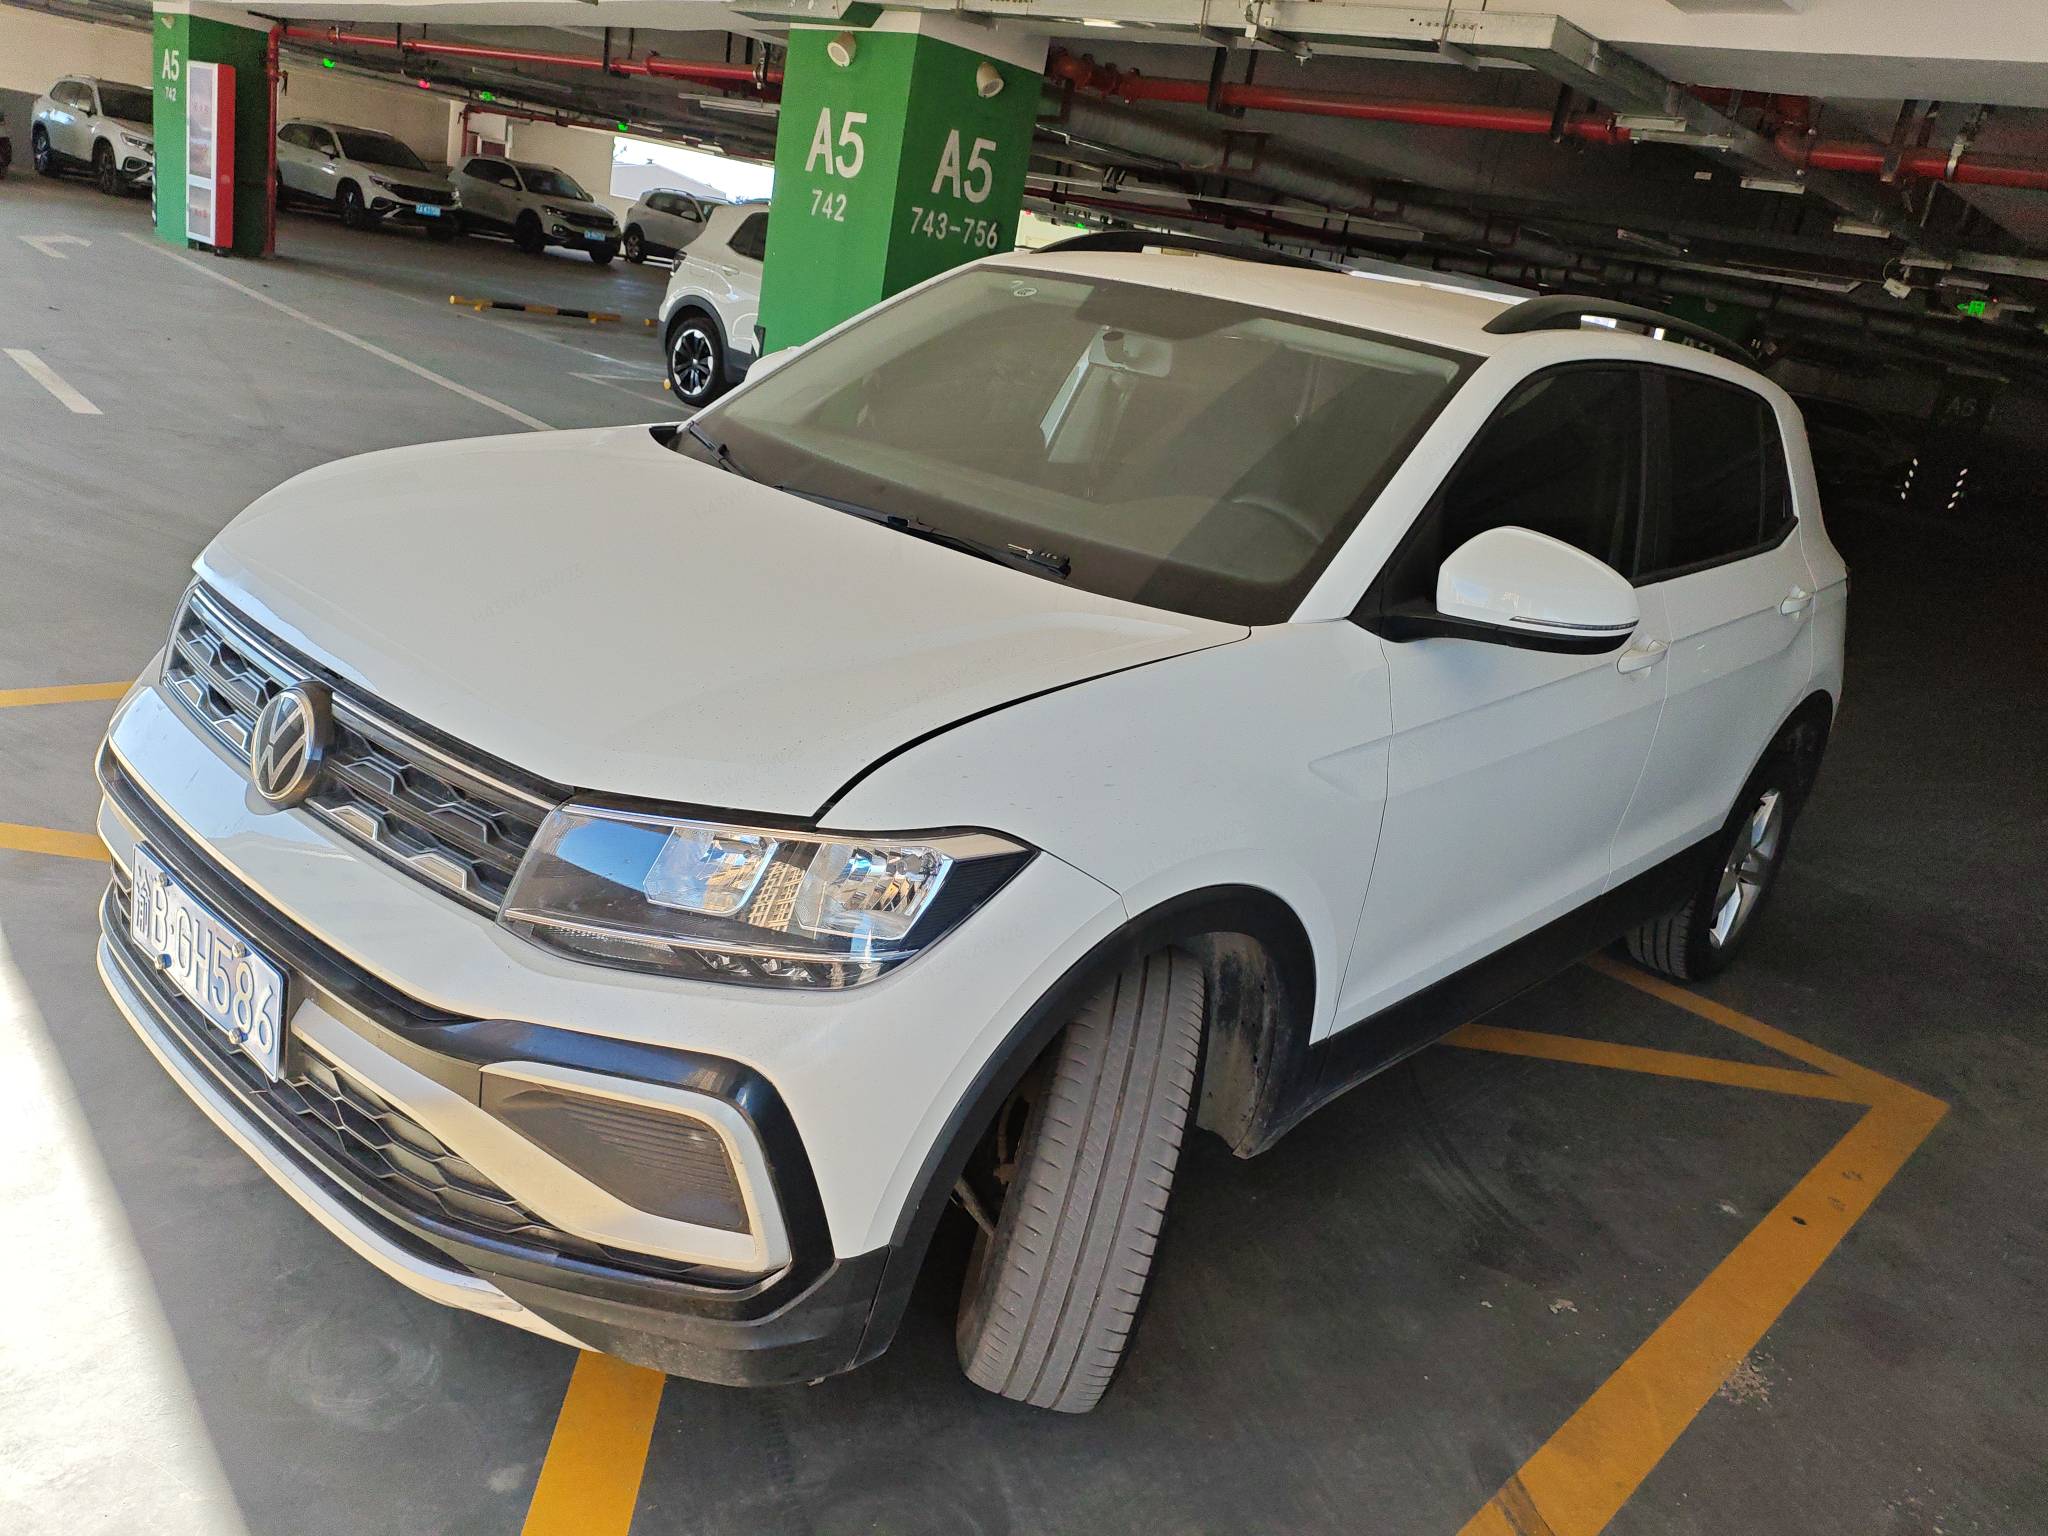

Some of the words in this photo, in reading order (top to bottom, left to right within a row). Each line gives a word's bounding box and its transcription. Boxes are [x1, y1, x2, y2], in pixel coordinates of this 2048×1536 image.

[162, 48, 180, 81] A5
[804, 107, 868, 179] A5
[931, 128, 997, 204] A5
[811, 189, 847, 222] 742
[910, 206, 998, 249] 743-756
